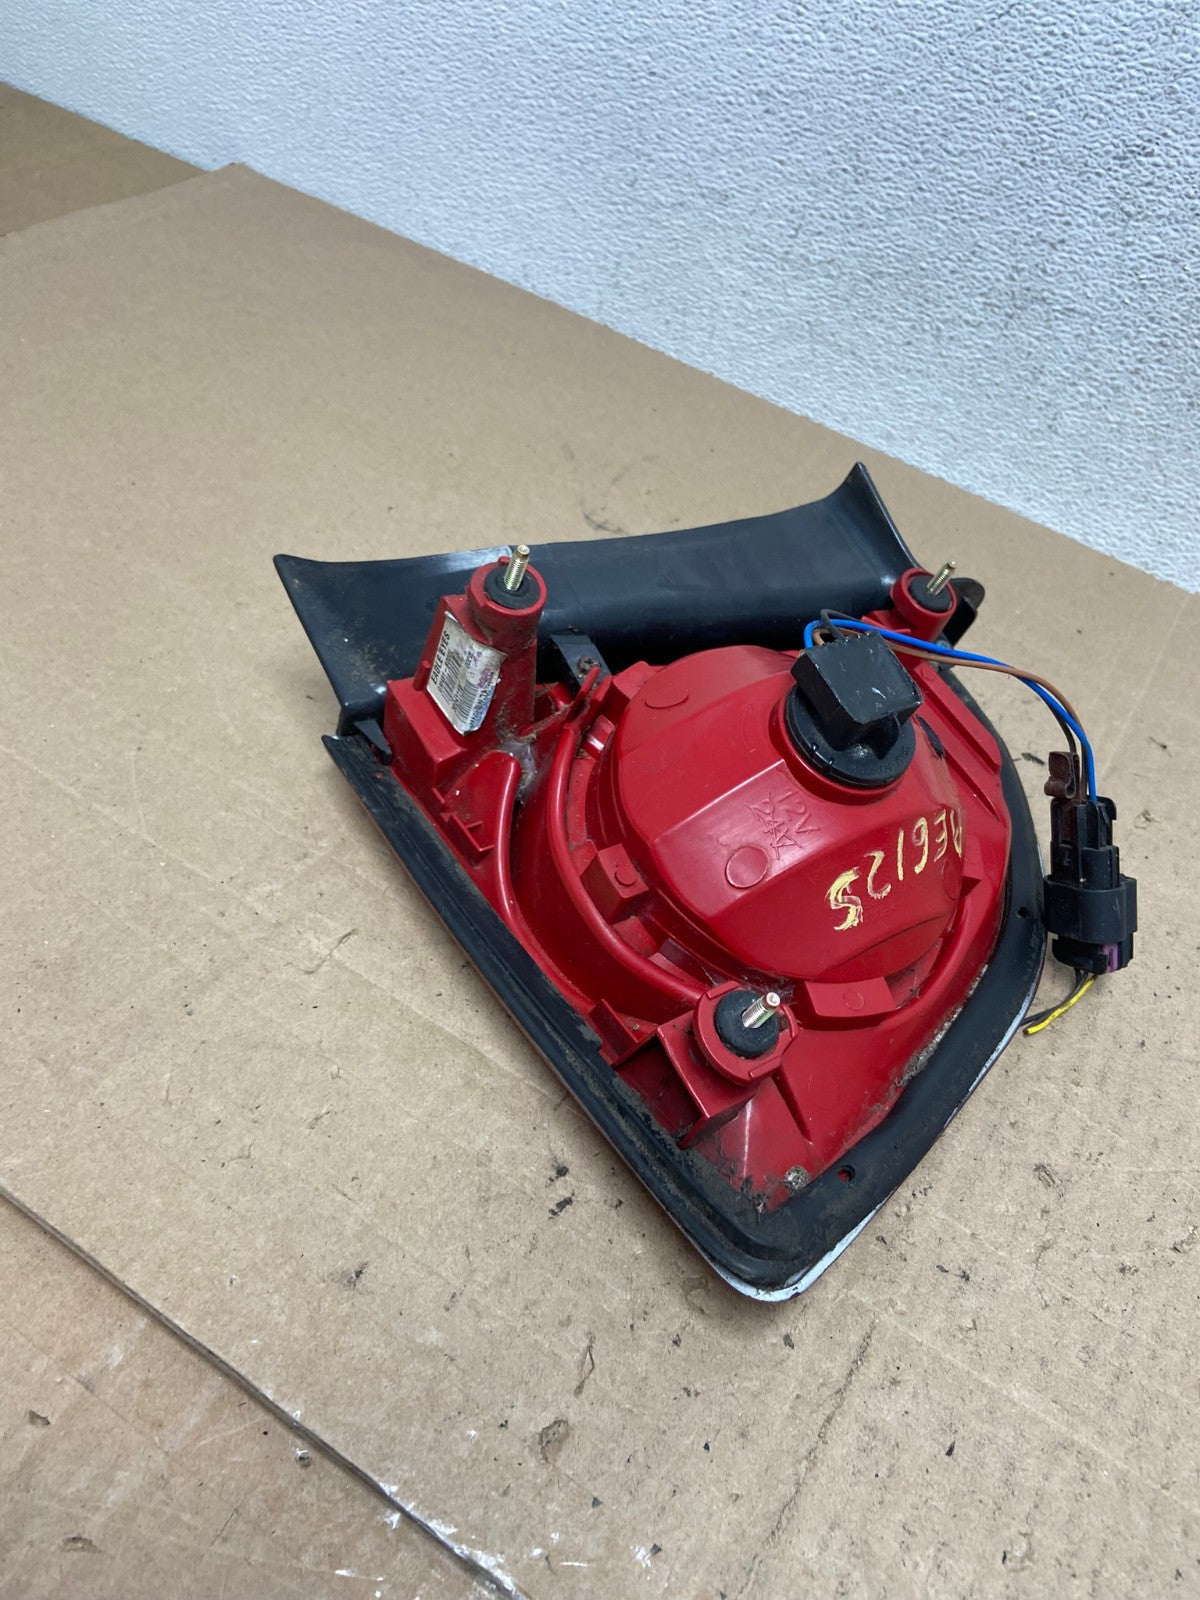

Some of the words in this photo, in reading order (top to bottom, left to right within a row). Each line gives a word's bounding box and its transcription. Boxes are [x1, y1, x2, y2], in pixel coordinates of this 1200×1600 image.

[431, 654, 445, 684] EAGLE
[441, 630, 451, 657] EYES
[776, 790, 821, 834] 12V
